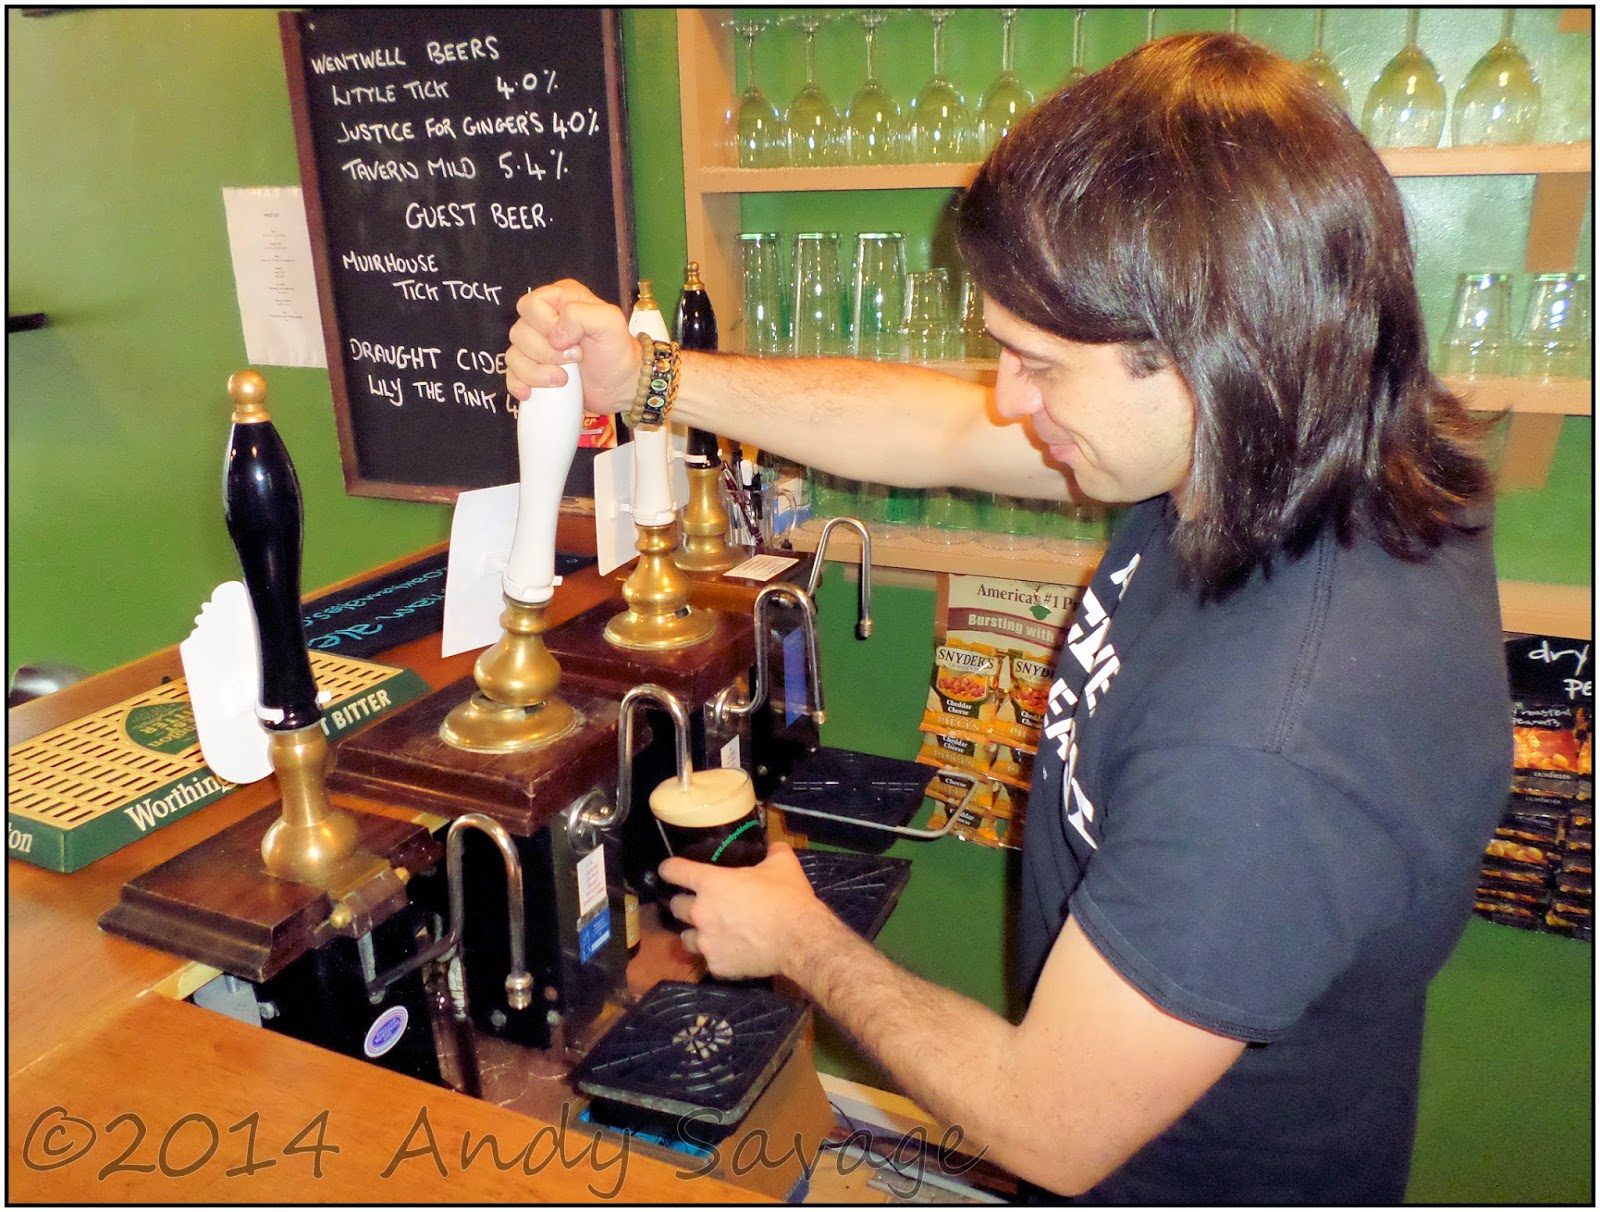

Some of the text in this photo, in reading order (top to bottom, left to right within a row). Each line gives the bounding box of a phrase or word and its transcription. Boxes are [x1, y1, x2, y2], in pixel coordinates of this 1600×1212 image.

[311, 35, 500, 75] WENTWELL BEERS
[332, 84, 397, 106] LITTLE
[403, 79, 450, 99] TICK
[337, 121, 415, 144] JUSTICE
[425, 117, 457, 139] FOR
[462, 109, 544, 135] GINGER'S
[341, 157, 420, 182] TAVERN
[428, 156, 476, 180] MILD
[405, 202, 477, 230] GUEST
[342, 250, 439, 274] MUIRHOUSE
[392, 279, 503, 306] TICK TOCK
[349, 337, 507, 375] DRAUGHT CIDE
[367, 374, 404, 407] LILY
[412, 380, 446, 403] THE
[453, 381, 497, 415] PINK
[967, 613, 1055, 643] Bursting with
[1015, 660, 1054, 680] SNYD
[1527, 640, 1590, 677] dry
[331, 688, 392, 731] BITTER
[946, 699, 973, 710] Cheddar
[947, 706, 970, 716] Cheese
[943, 741, 965, 754] Cheese
[944, 777, 967, 788] Cheese
